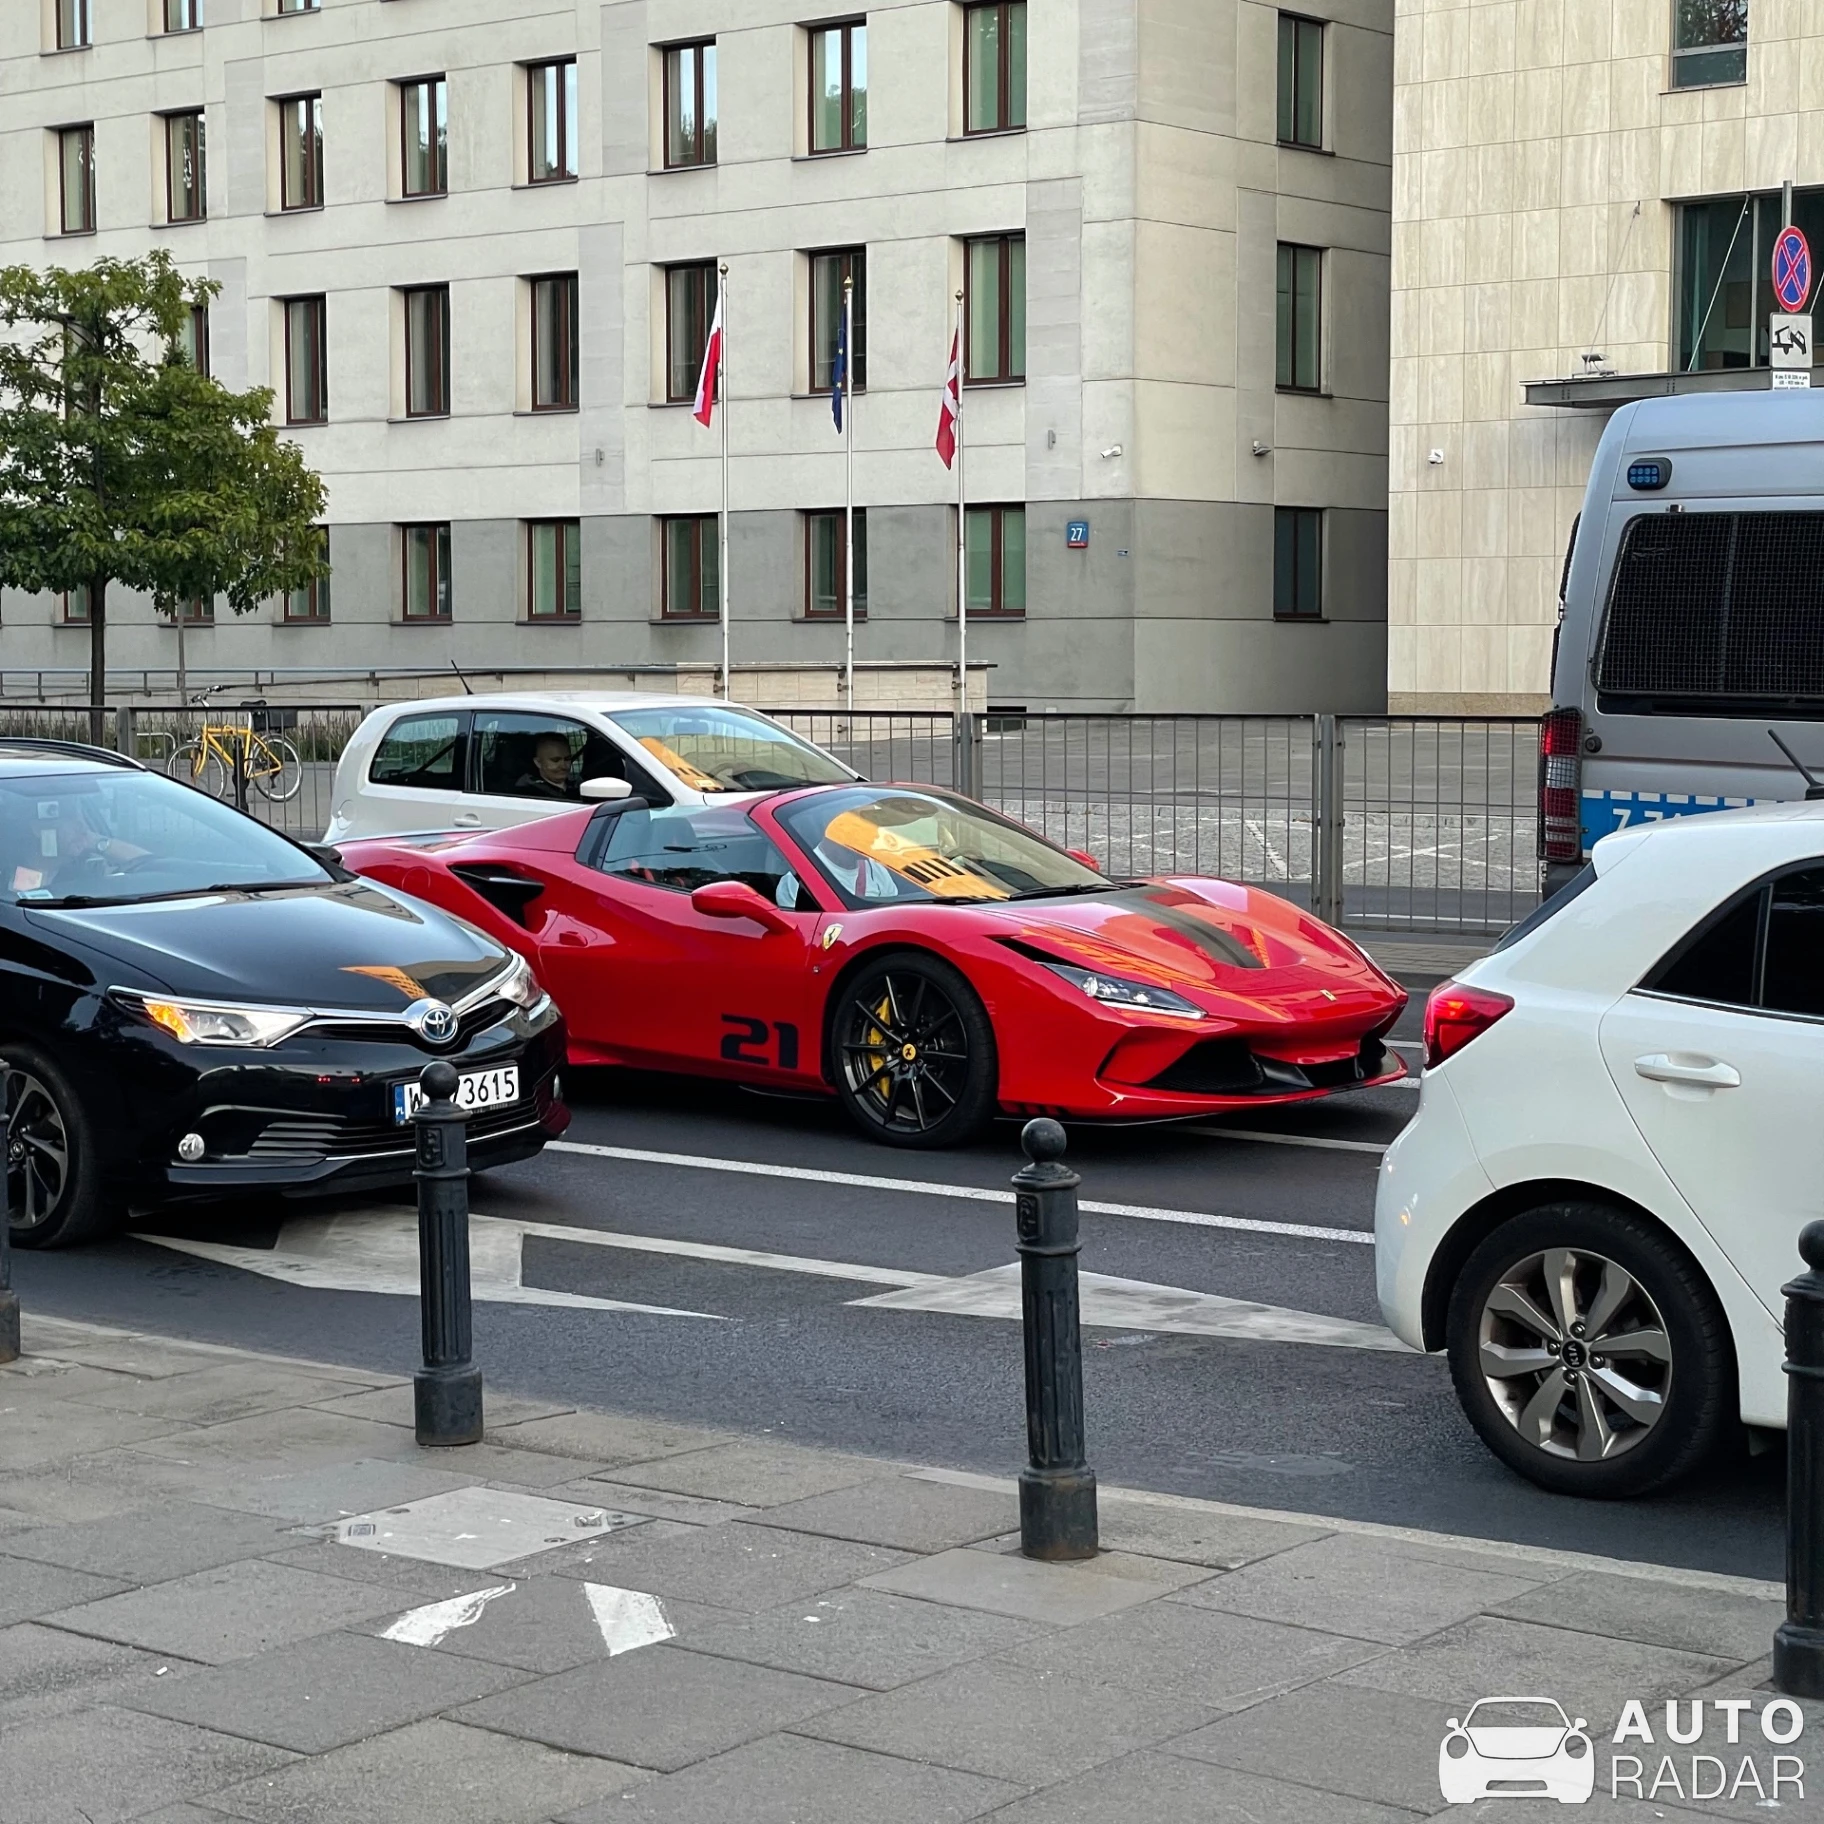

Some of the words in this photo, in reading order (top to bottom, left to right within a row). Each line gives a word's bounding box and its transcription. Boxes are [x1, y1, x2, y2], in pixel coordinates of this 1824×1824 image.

[1071, 528, 1082, 541] 27
[721, 1013, 798, 1069] 21
[396, 1106, 404, 1115] PL
